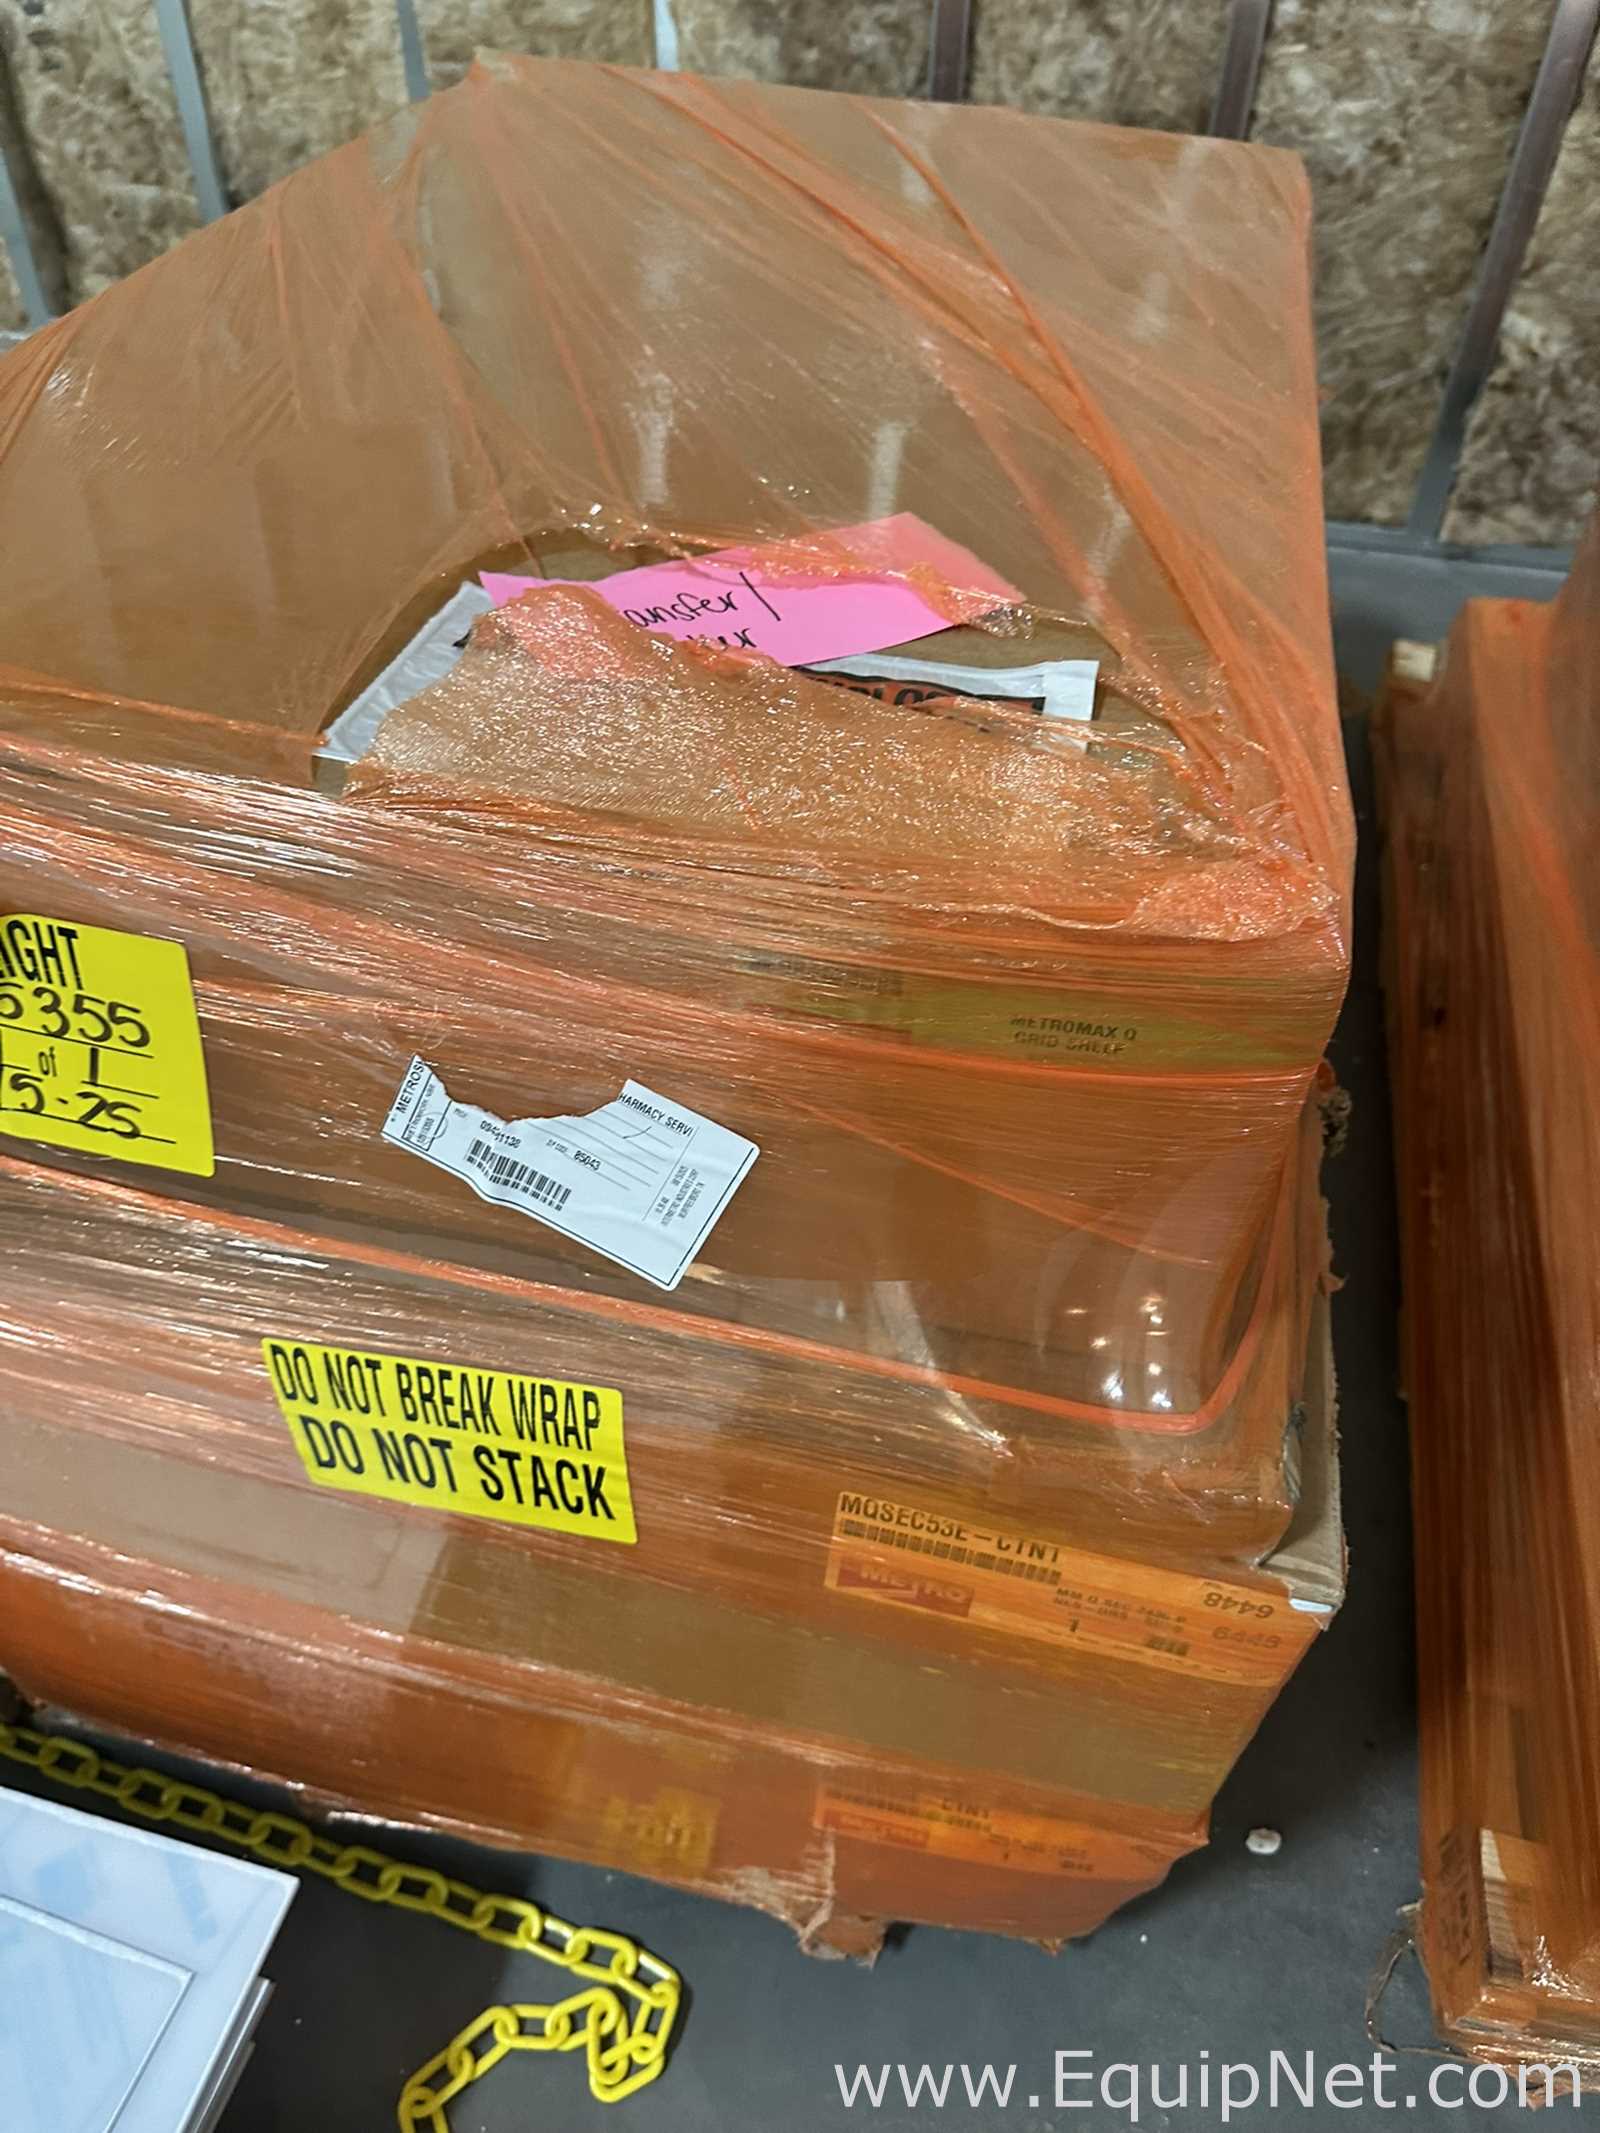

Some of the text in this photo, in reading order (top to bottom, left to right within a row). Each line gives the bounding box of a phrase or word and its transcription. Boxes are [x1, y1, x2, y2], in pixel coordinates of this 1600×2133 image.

[0, 919, 84, 990] IGHT
[37, 1046, 57, 1077] of
[1010, 1017, 1120, 1039] METROMAX
[270, 1343, 600, 1451] DO NOT BREAK WRAP
[299, 1413, 616, 1520] DO NOT STACK
